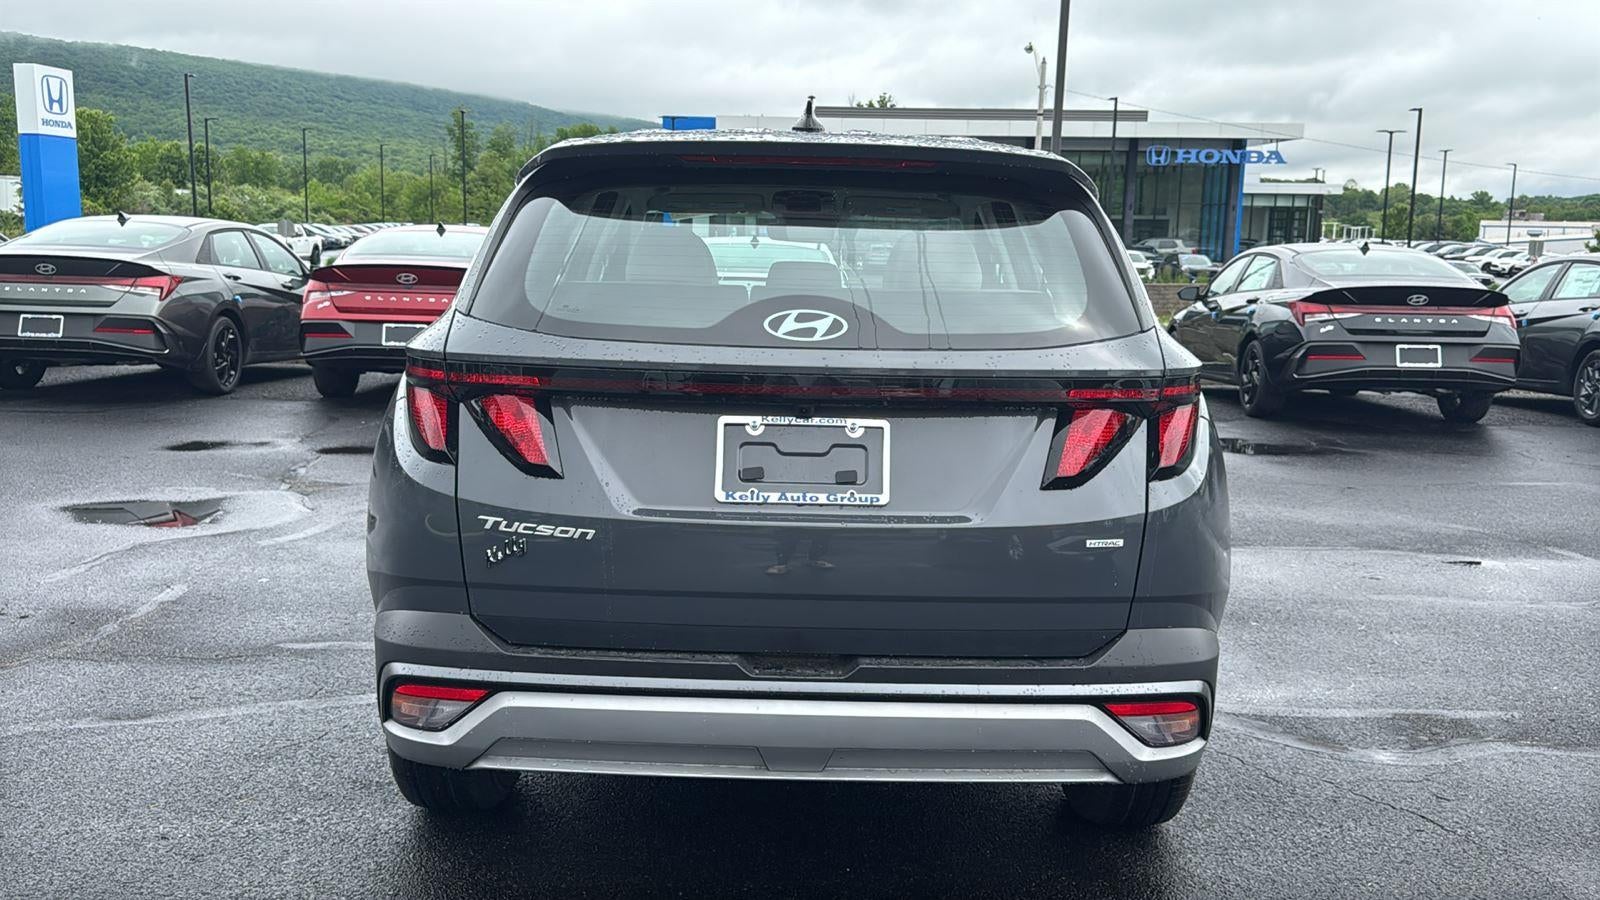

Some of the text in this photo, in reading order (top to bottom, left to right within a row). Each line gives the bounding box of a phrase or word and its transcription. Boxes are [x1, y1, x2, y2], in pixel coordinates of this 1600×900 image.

[41, 118, 73, 130] HONDA
[1174, 148, 1287, 164] HONDA
[4, 286, 87, 294] ELANTRA
[364, 295, 449, 303] ELANTRA
[725, 491, 881, 505] Kelly Auto Group
